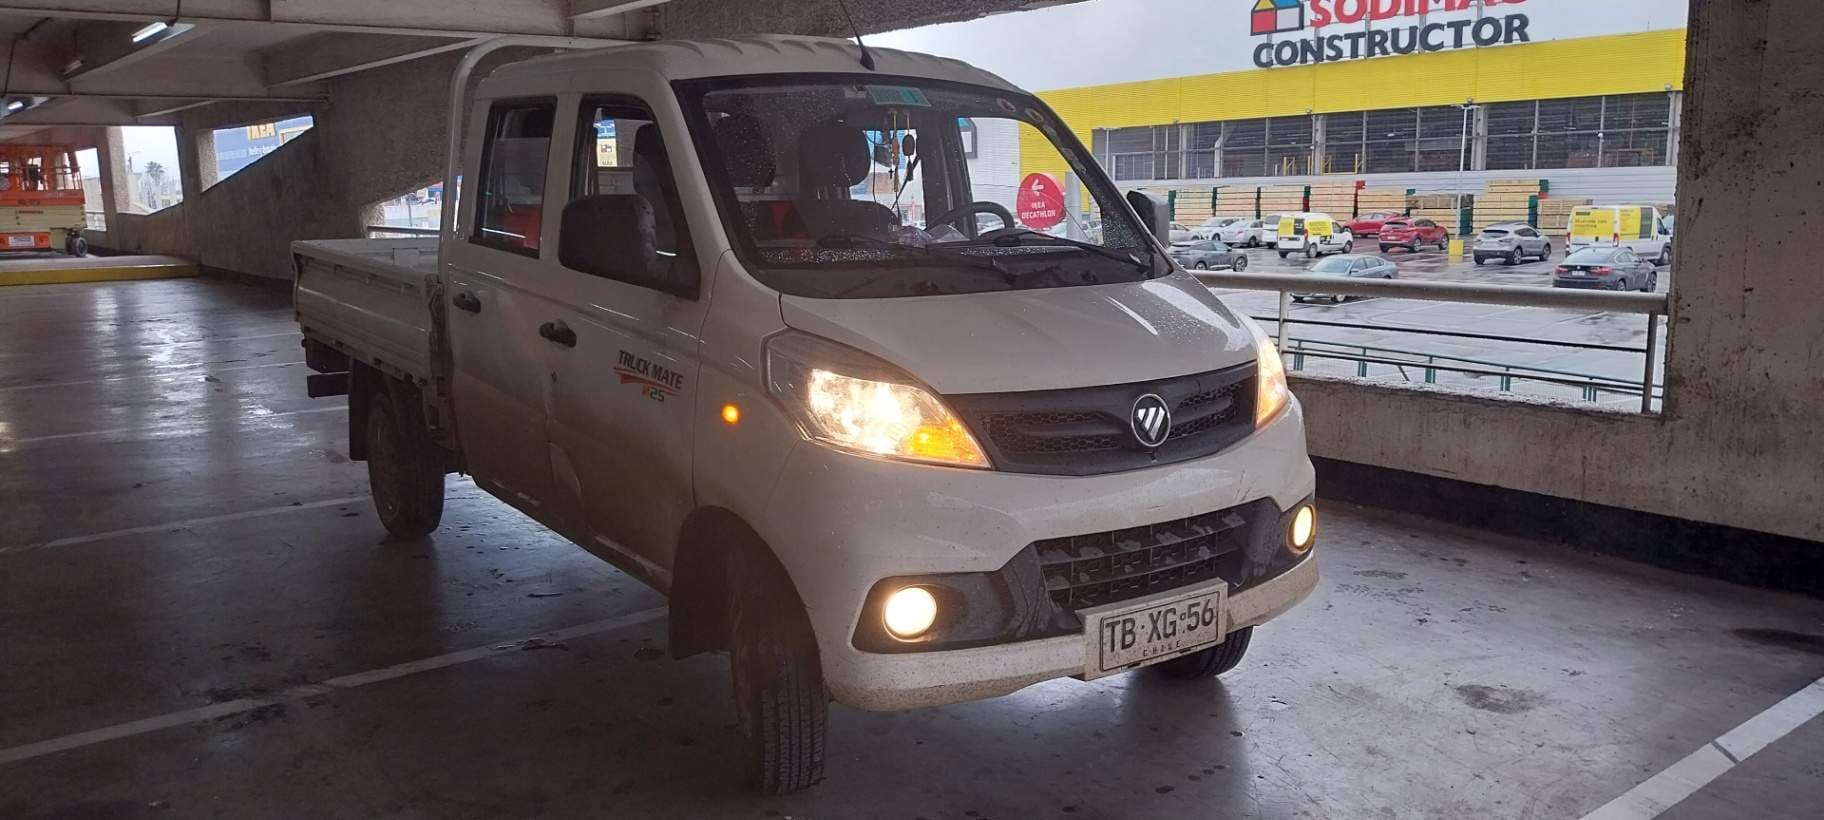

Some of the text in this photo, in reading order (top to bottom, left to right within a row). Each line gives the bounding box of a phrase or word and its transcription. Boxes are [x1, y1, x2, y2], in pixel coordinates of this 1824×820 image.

[1253, 14, 1530, 68] CONSTRUCTOR
[1021, 210, 1056, 219] DECATHLON
[618, 349, 684, 390] TRUCK MATE
